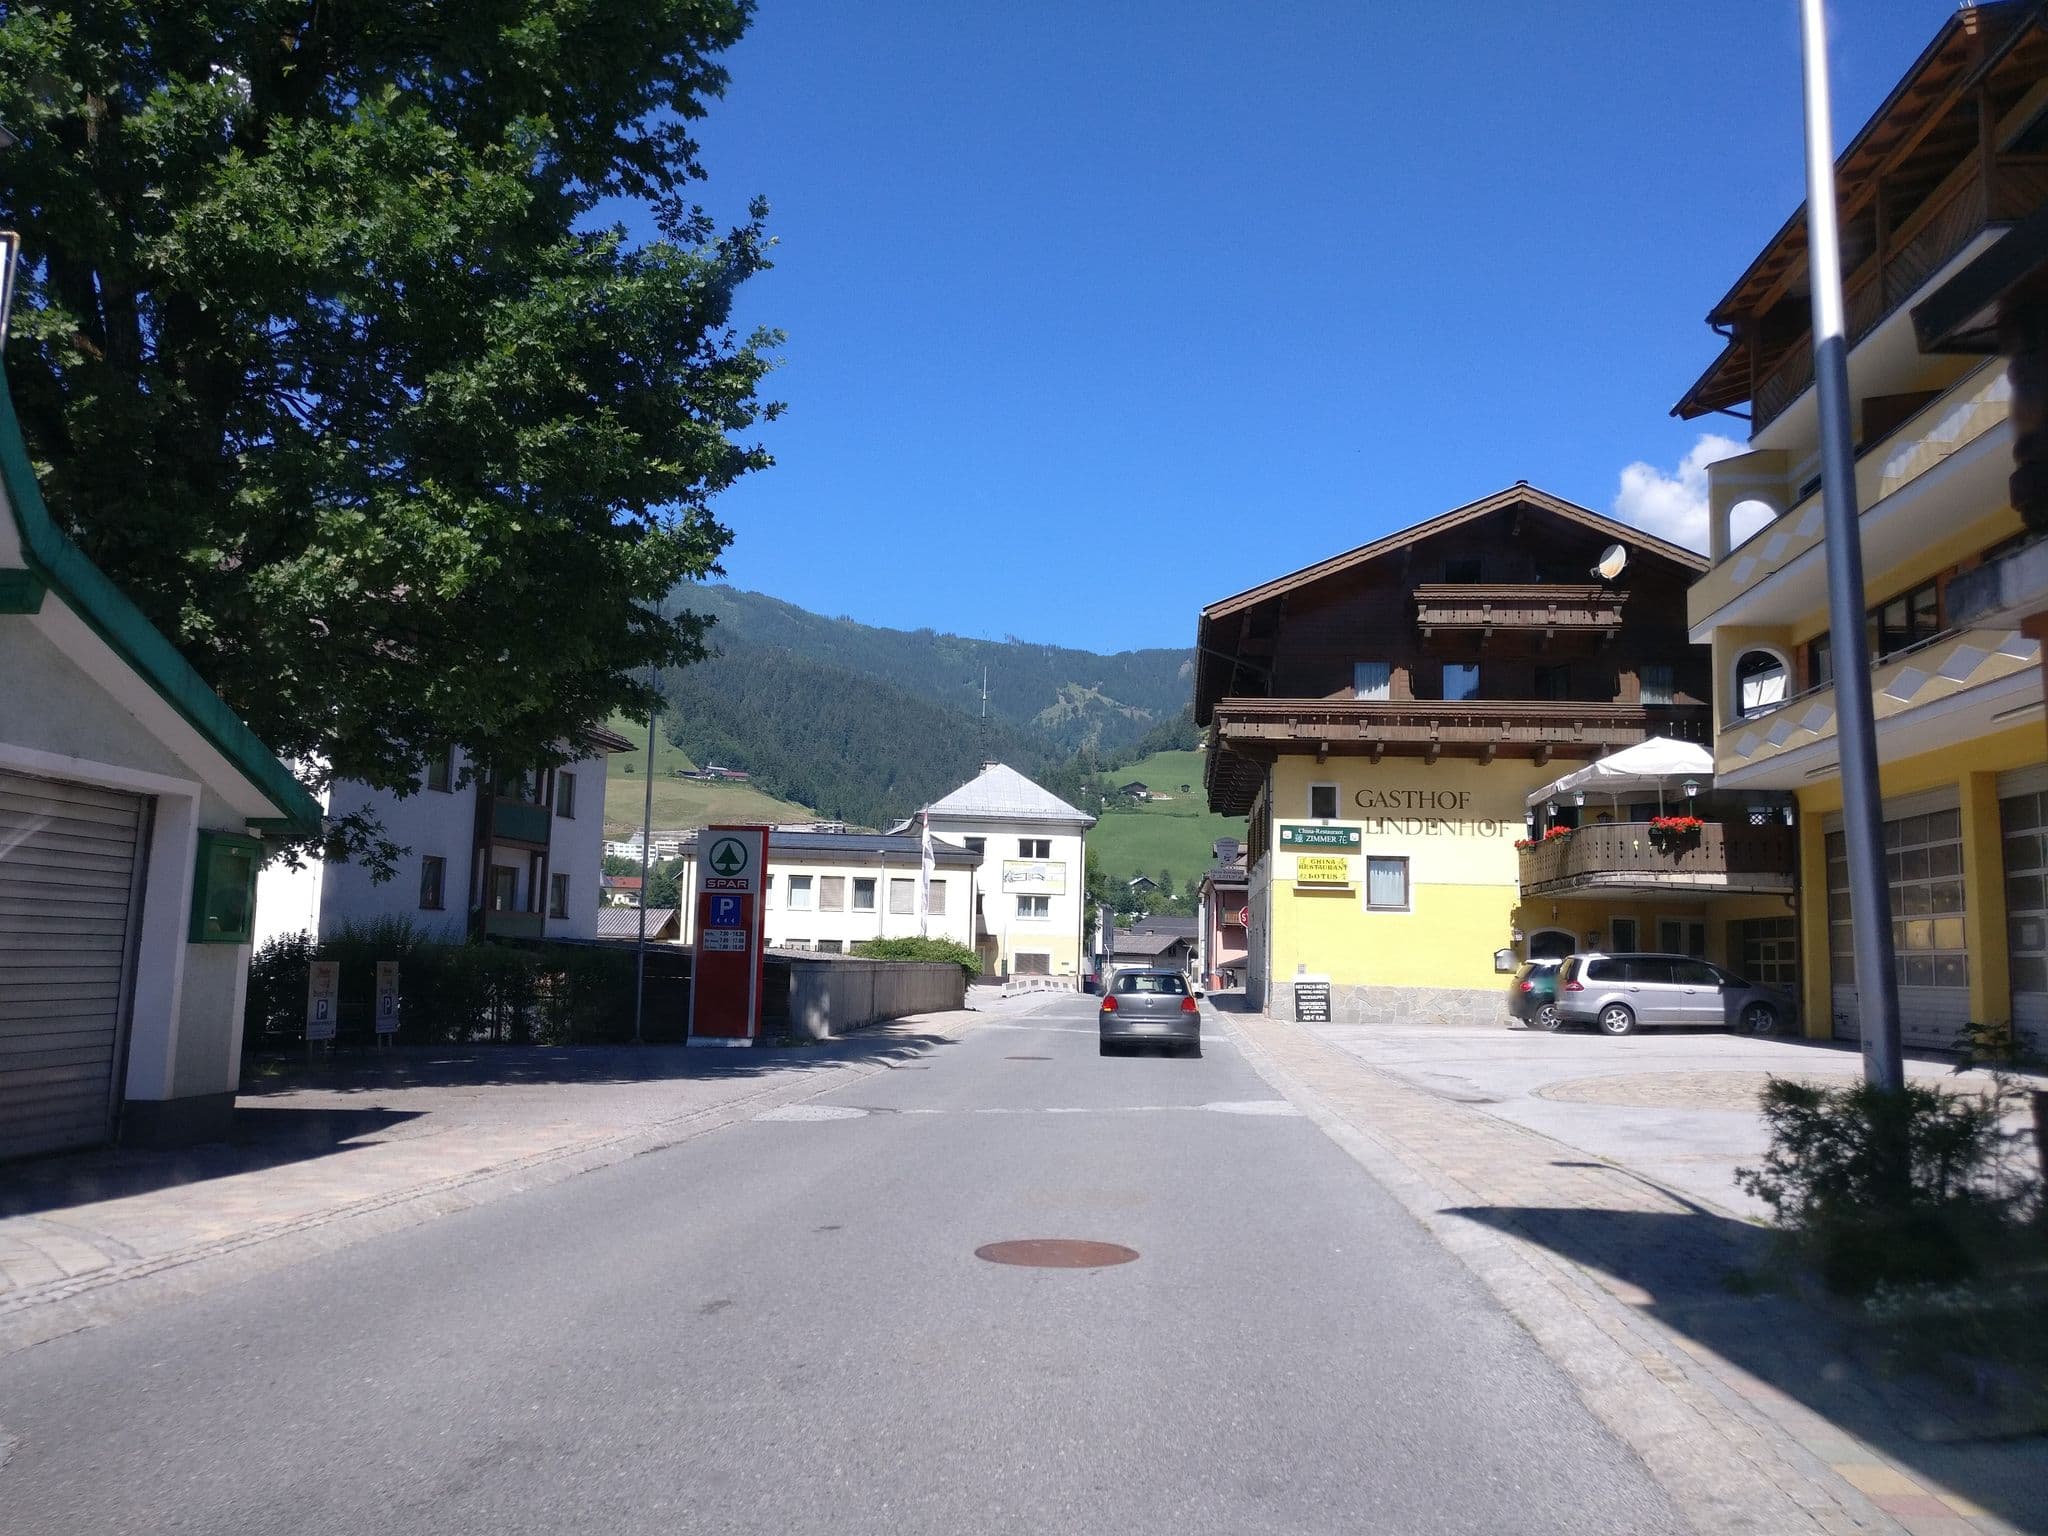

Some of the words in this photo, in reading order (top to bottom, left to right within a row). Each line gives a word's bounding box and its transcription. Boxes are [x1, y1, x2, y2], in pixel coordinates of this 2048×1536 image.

[1355, 789, 1471, 809] GASTHOF
[1365, 816, 1510, 837] LINDENHOF
[1305, 835, 1337, 843] ZIMMER
[707, 879, 747, 888] SPAR
[719, 898, 734, 916] P
[318, 1000, 327, 1019] P
[384, 997, 391, 1014] P
